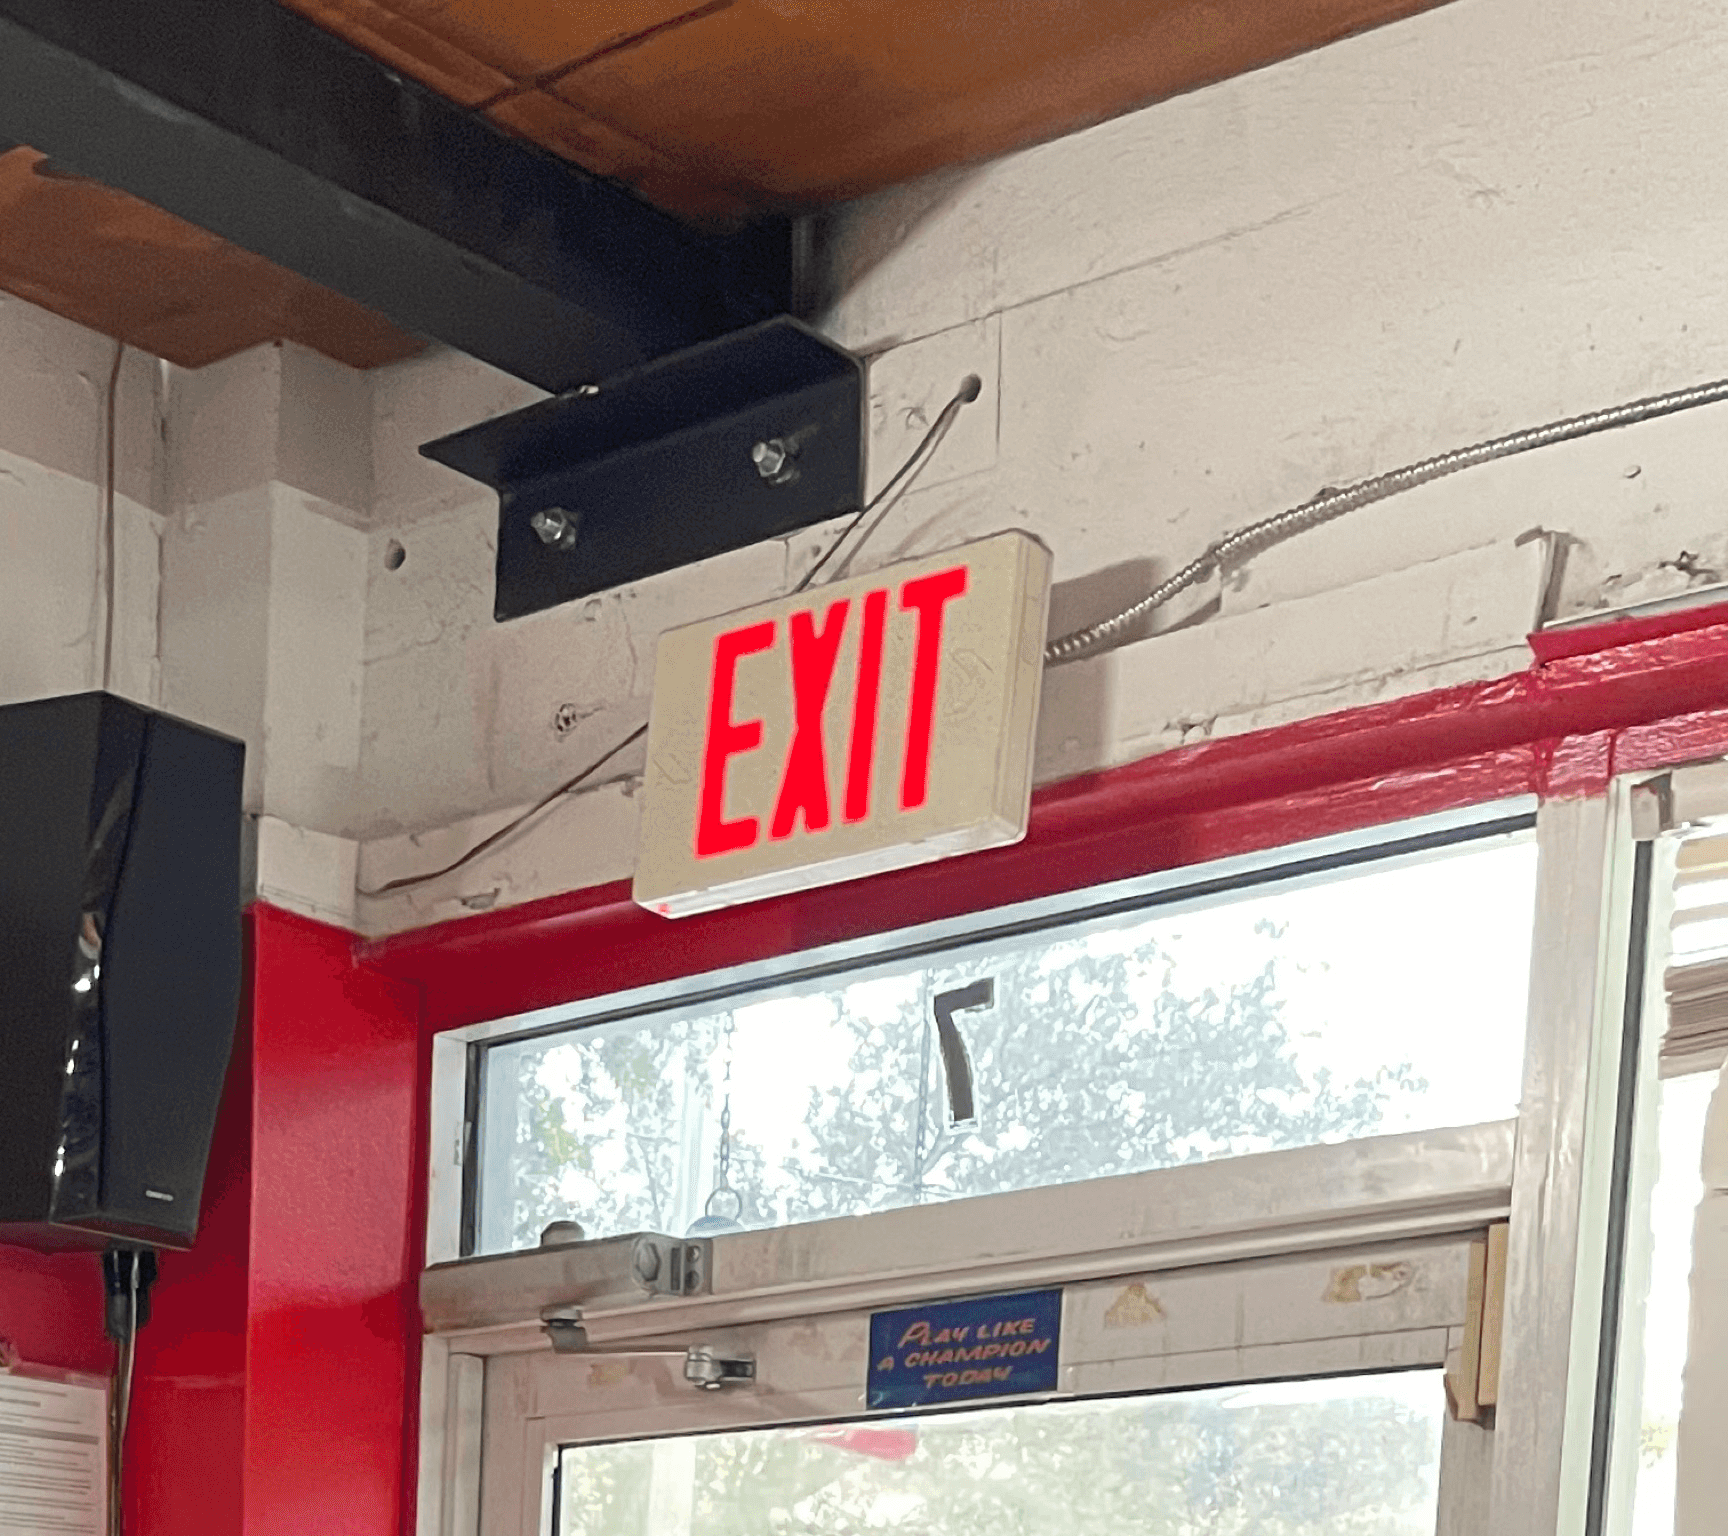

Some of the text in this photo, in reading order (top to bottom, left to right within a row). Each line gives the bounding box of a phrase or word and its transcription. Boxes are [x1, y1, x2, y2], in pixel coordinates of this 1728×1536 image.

[693, 565, 970, 860] EXIT
[897, 1318, 1036, 1349] PLAY LIKE
[877, 1339, 1052, 1371] A CHAMPION
[924, 1366, 1013, 1389] TODAY
